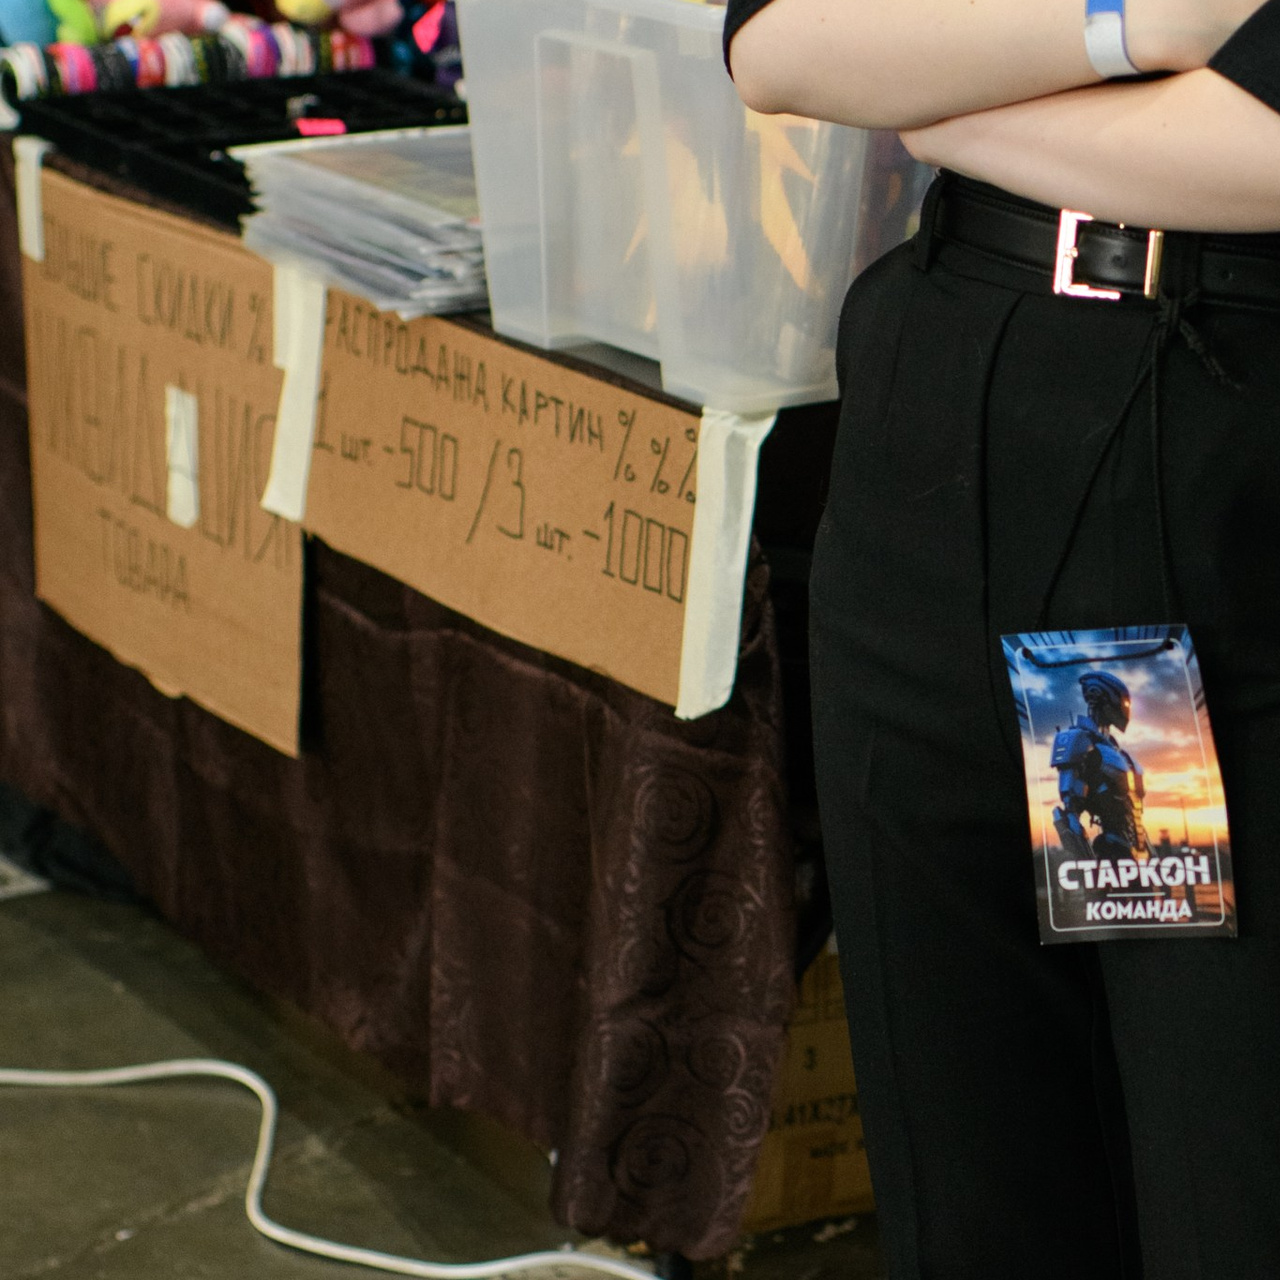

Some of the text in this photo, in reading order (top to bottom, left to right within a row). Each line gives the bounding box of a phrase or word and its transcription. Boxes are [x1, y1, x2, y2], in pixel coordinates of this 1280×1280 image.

[326, 298, 490, 413] АСПРОДАЖА
[502, 371, 604, 453] КАРТИН
[1057, 855, 1212, 891] СТАРКОН
[1085, 898, 1194, 922] КОМАНДА
